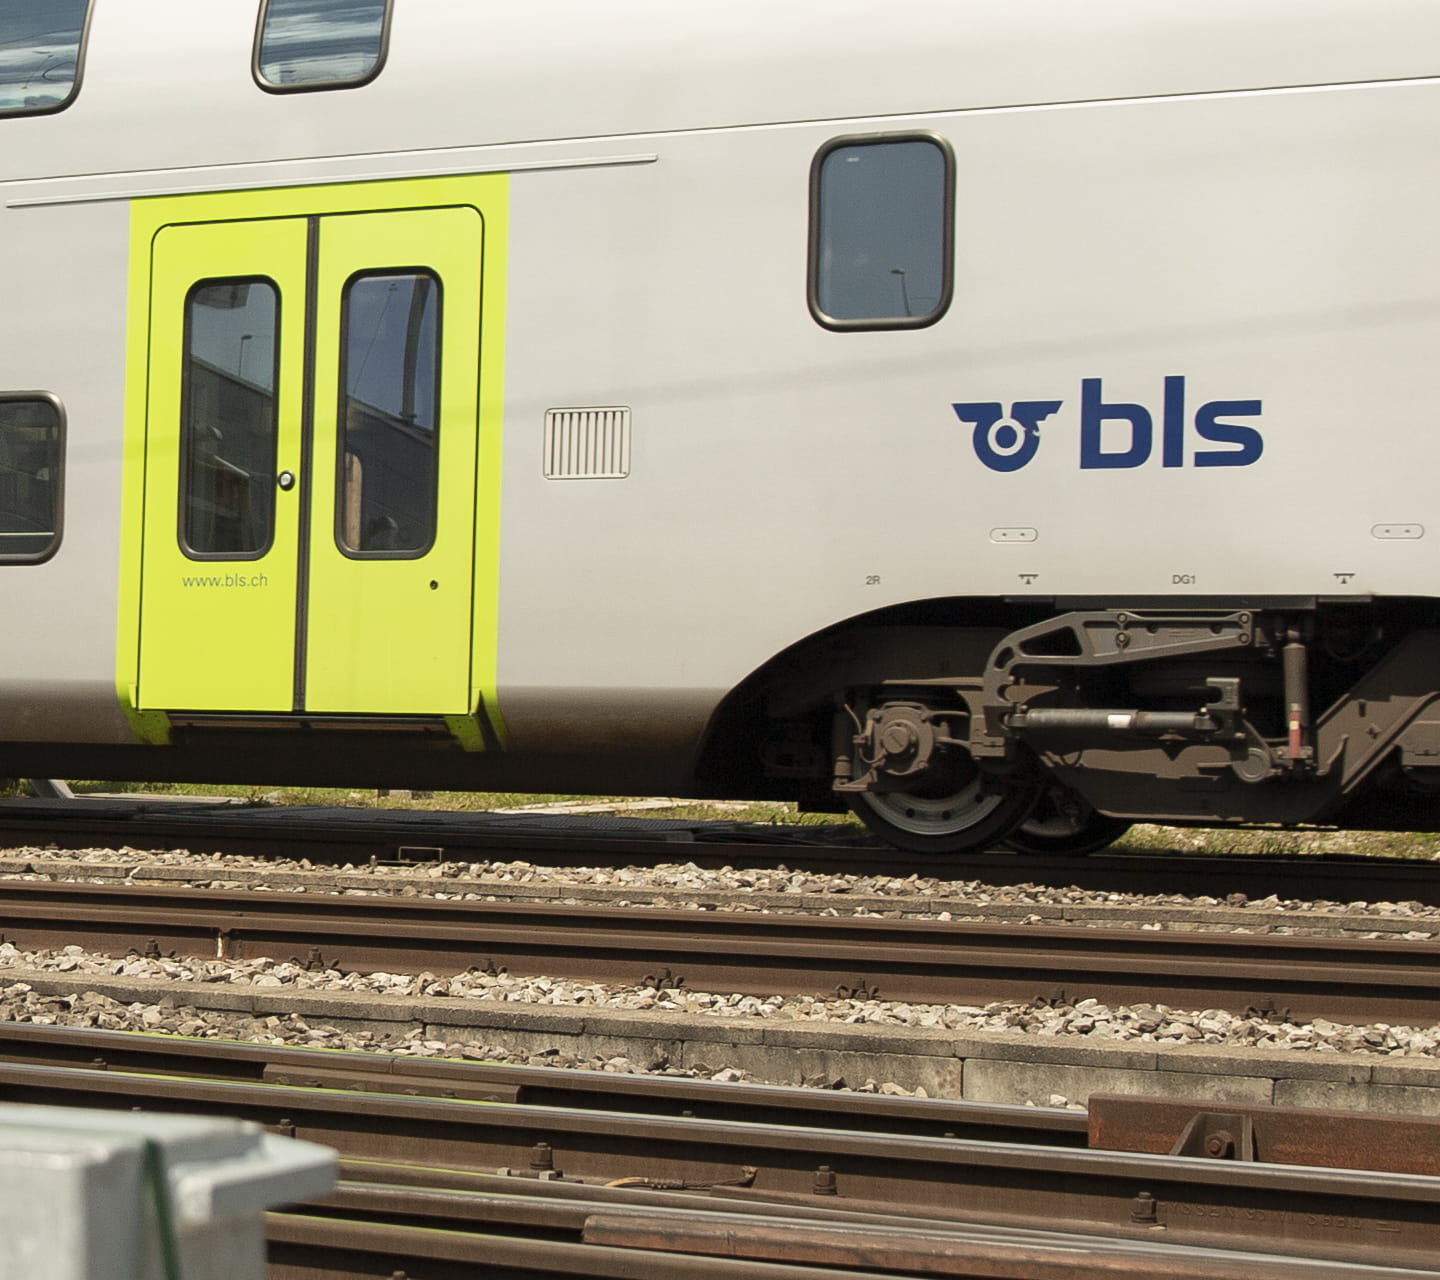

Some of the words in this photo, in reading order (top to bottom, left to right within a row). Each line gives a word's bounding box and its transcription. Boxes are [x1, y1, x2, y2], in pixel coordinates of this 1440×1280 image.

[1080, 375, 1264, 469] bls
[182, 573, 268, 587] www.bls.ch
[865, 575, 880, 585] 2R
[1172, 574, 1196, 585] DG1
